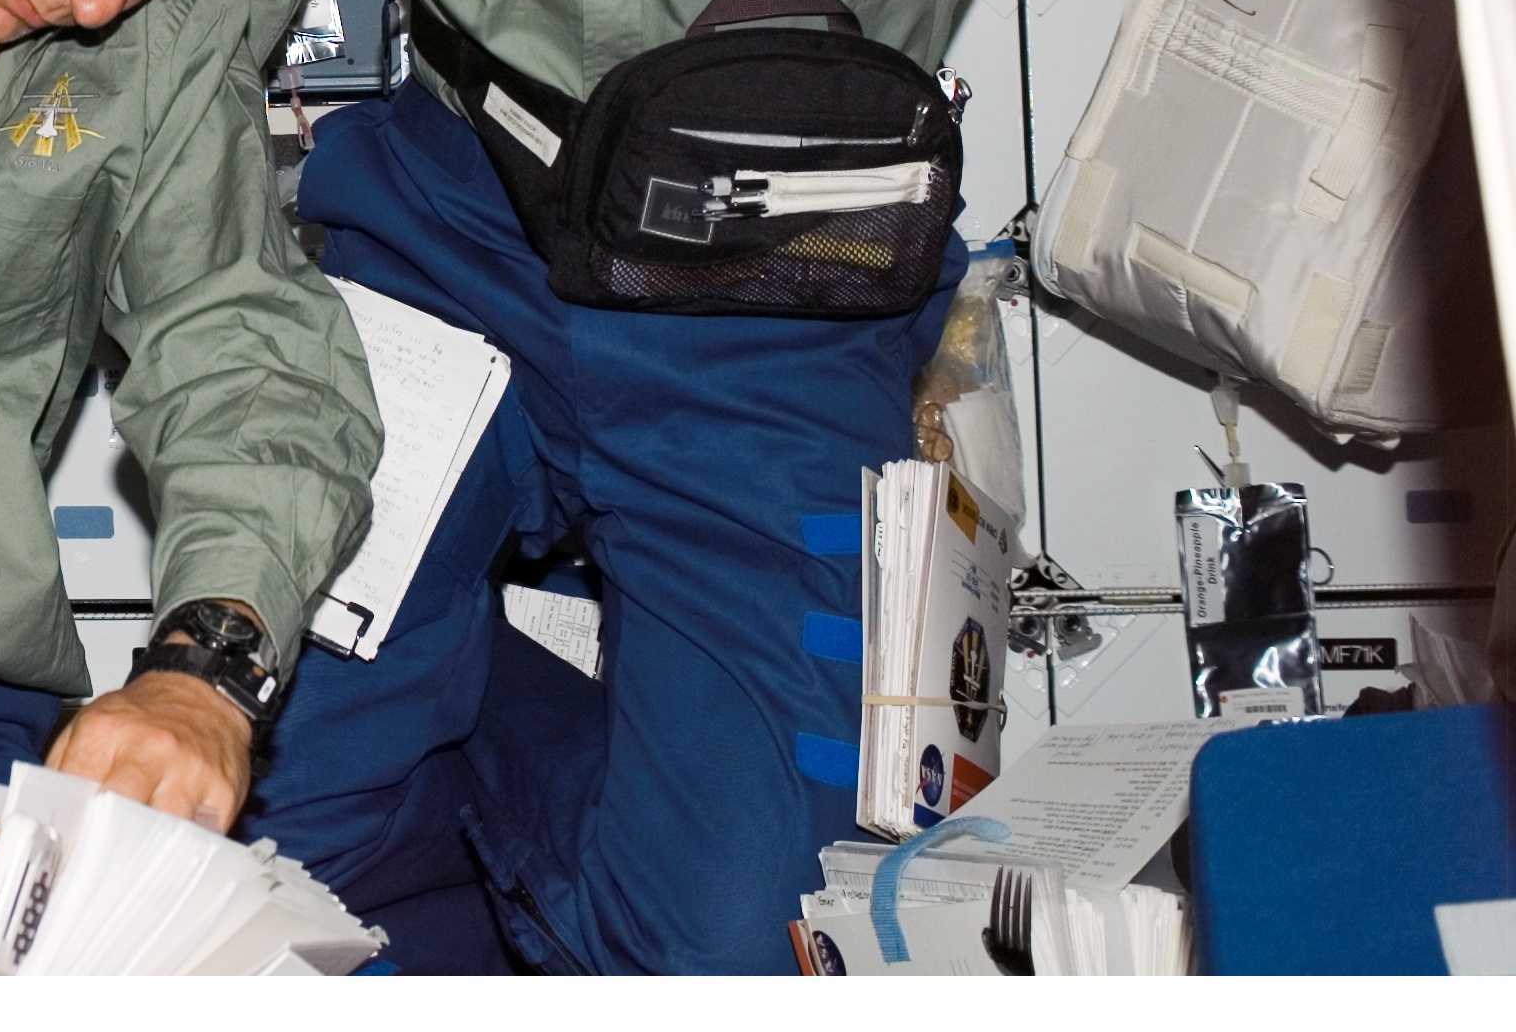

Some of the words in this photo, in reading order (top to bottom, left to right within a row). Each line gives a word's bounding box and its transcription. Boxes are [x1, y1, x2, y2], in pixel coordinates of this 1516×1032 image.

[1192, 522, 1207, 618] Orange-Pineapple
[1208, 556, 1218, 585] Drink
[1319, 645, 1384, 663] MF71K
[921, 764, 942, 787] NASA
